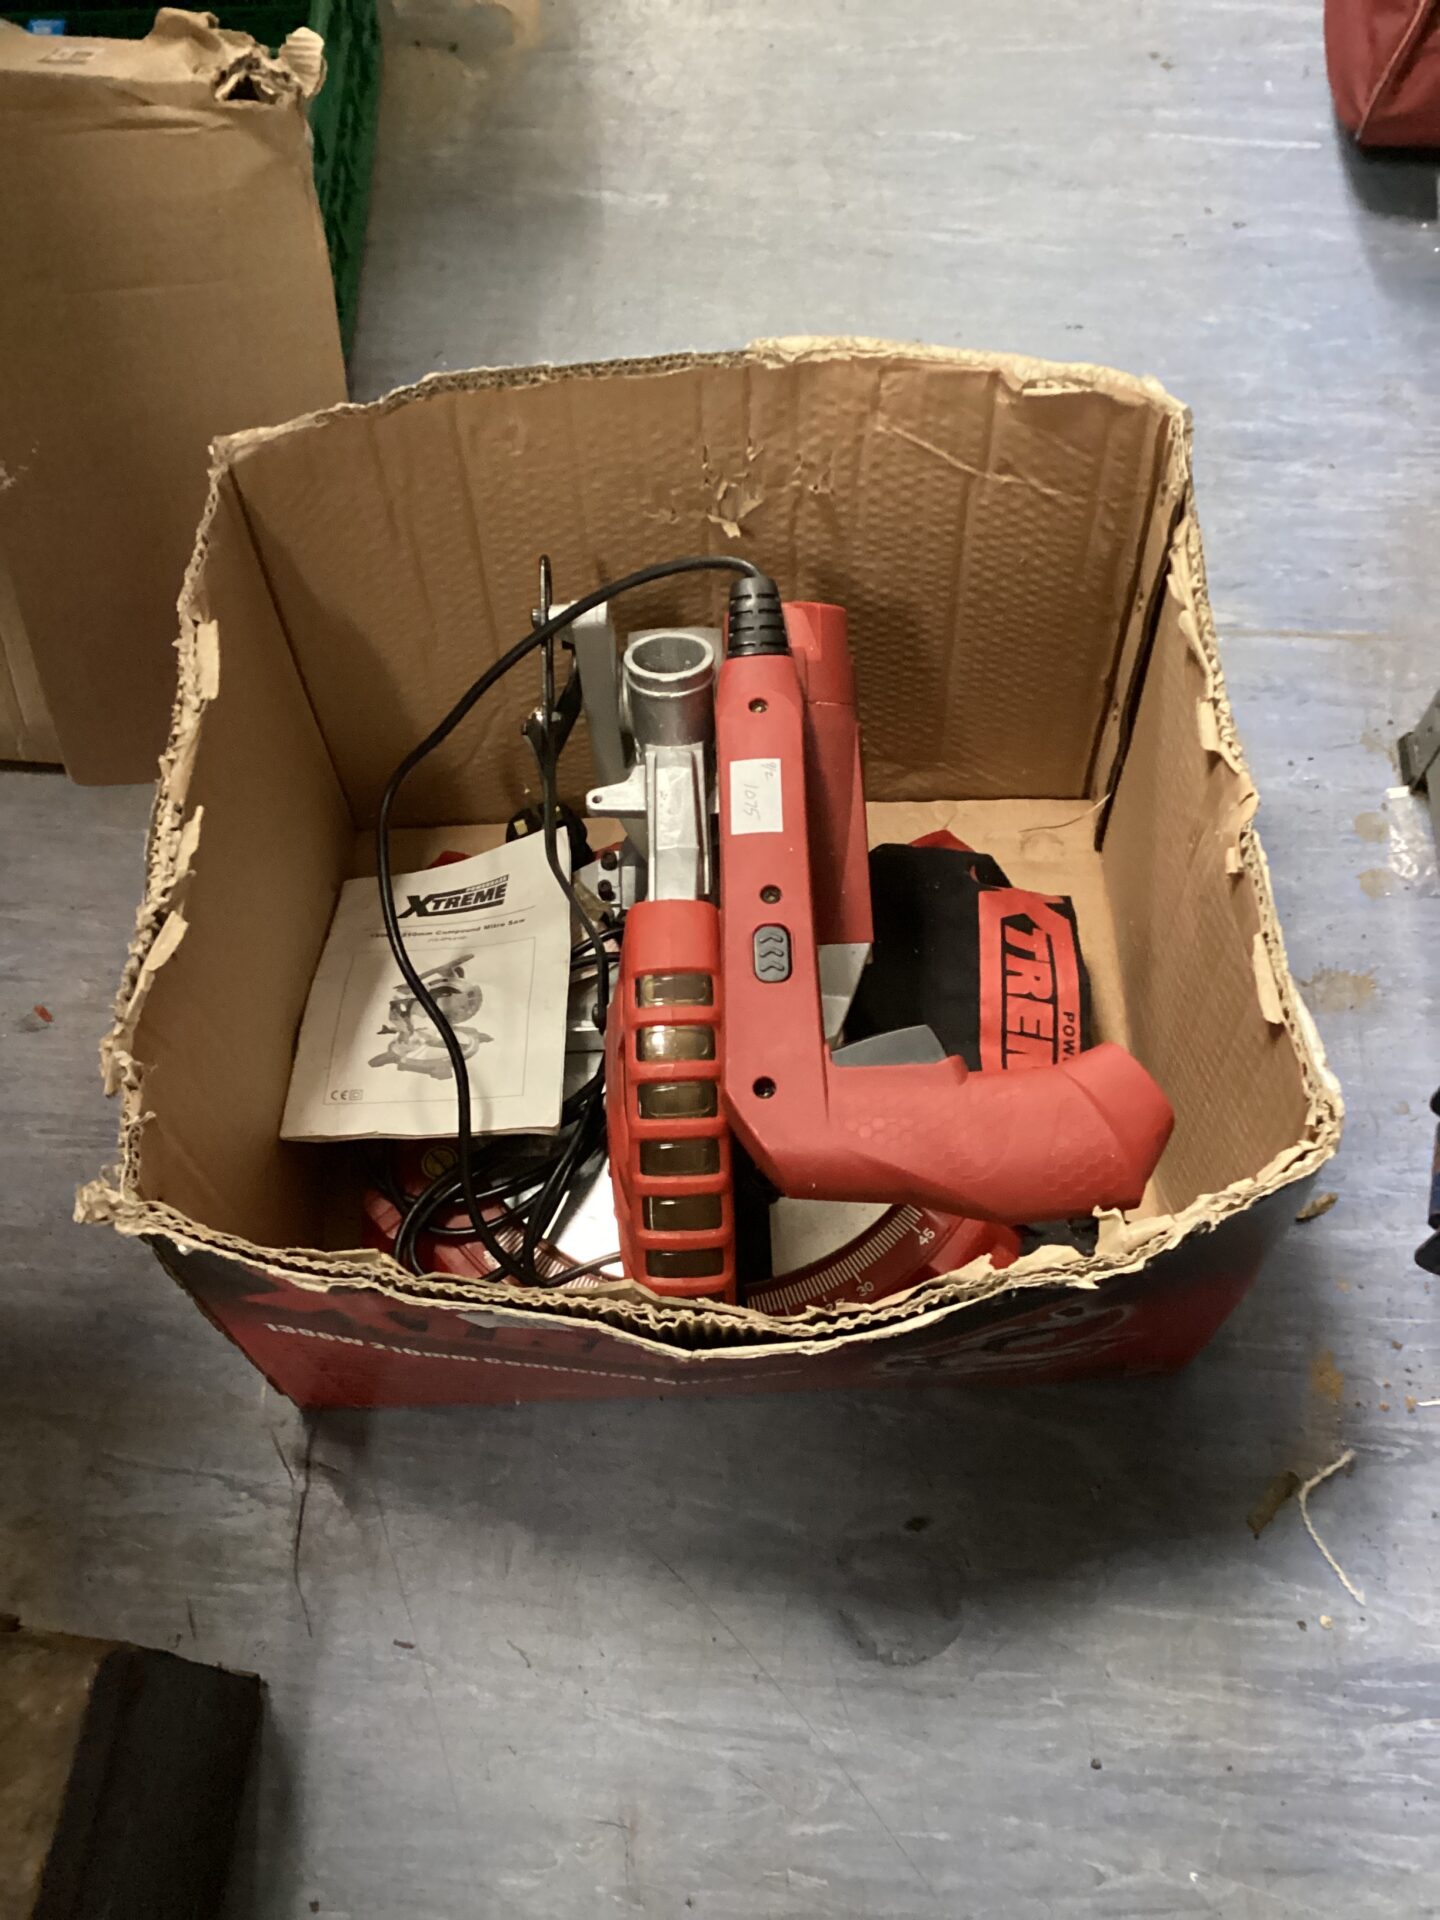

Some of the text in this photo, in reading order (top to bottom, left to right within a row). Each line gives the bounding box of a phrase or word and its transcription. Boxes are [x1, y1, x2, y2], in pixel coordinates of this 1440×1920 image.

[397, 883, 508, 918] XTREME
[436, 926, 481, 936] Compound
[484, 922, 505, 930] Mitre
[508, 918, 525, 926] Saw
[1063, 1011, 1075, 1062] POW
[919, 1227, 936, 1245] 45
[856, 1281, 874, 1296] 30
